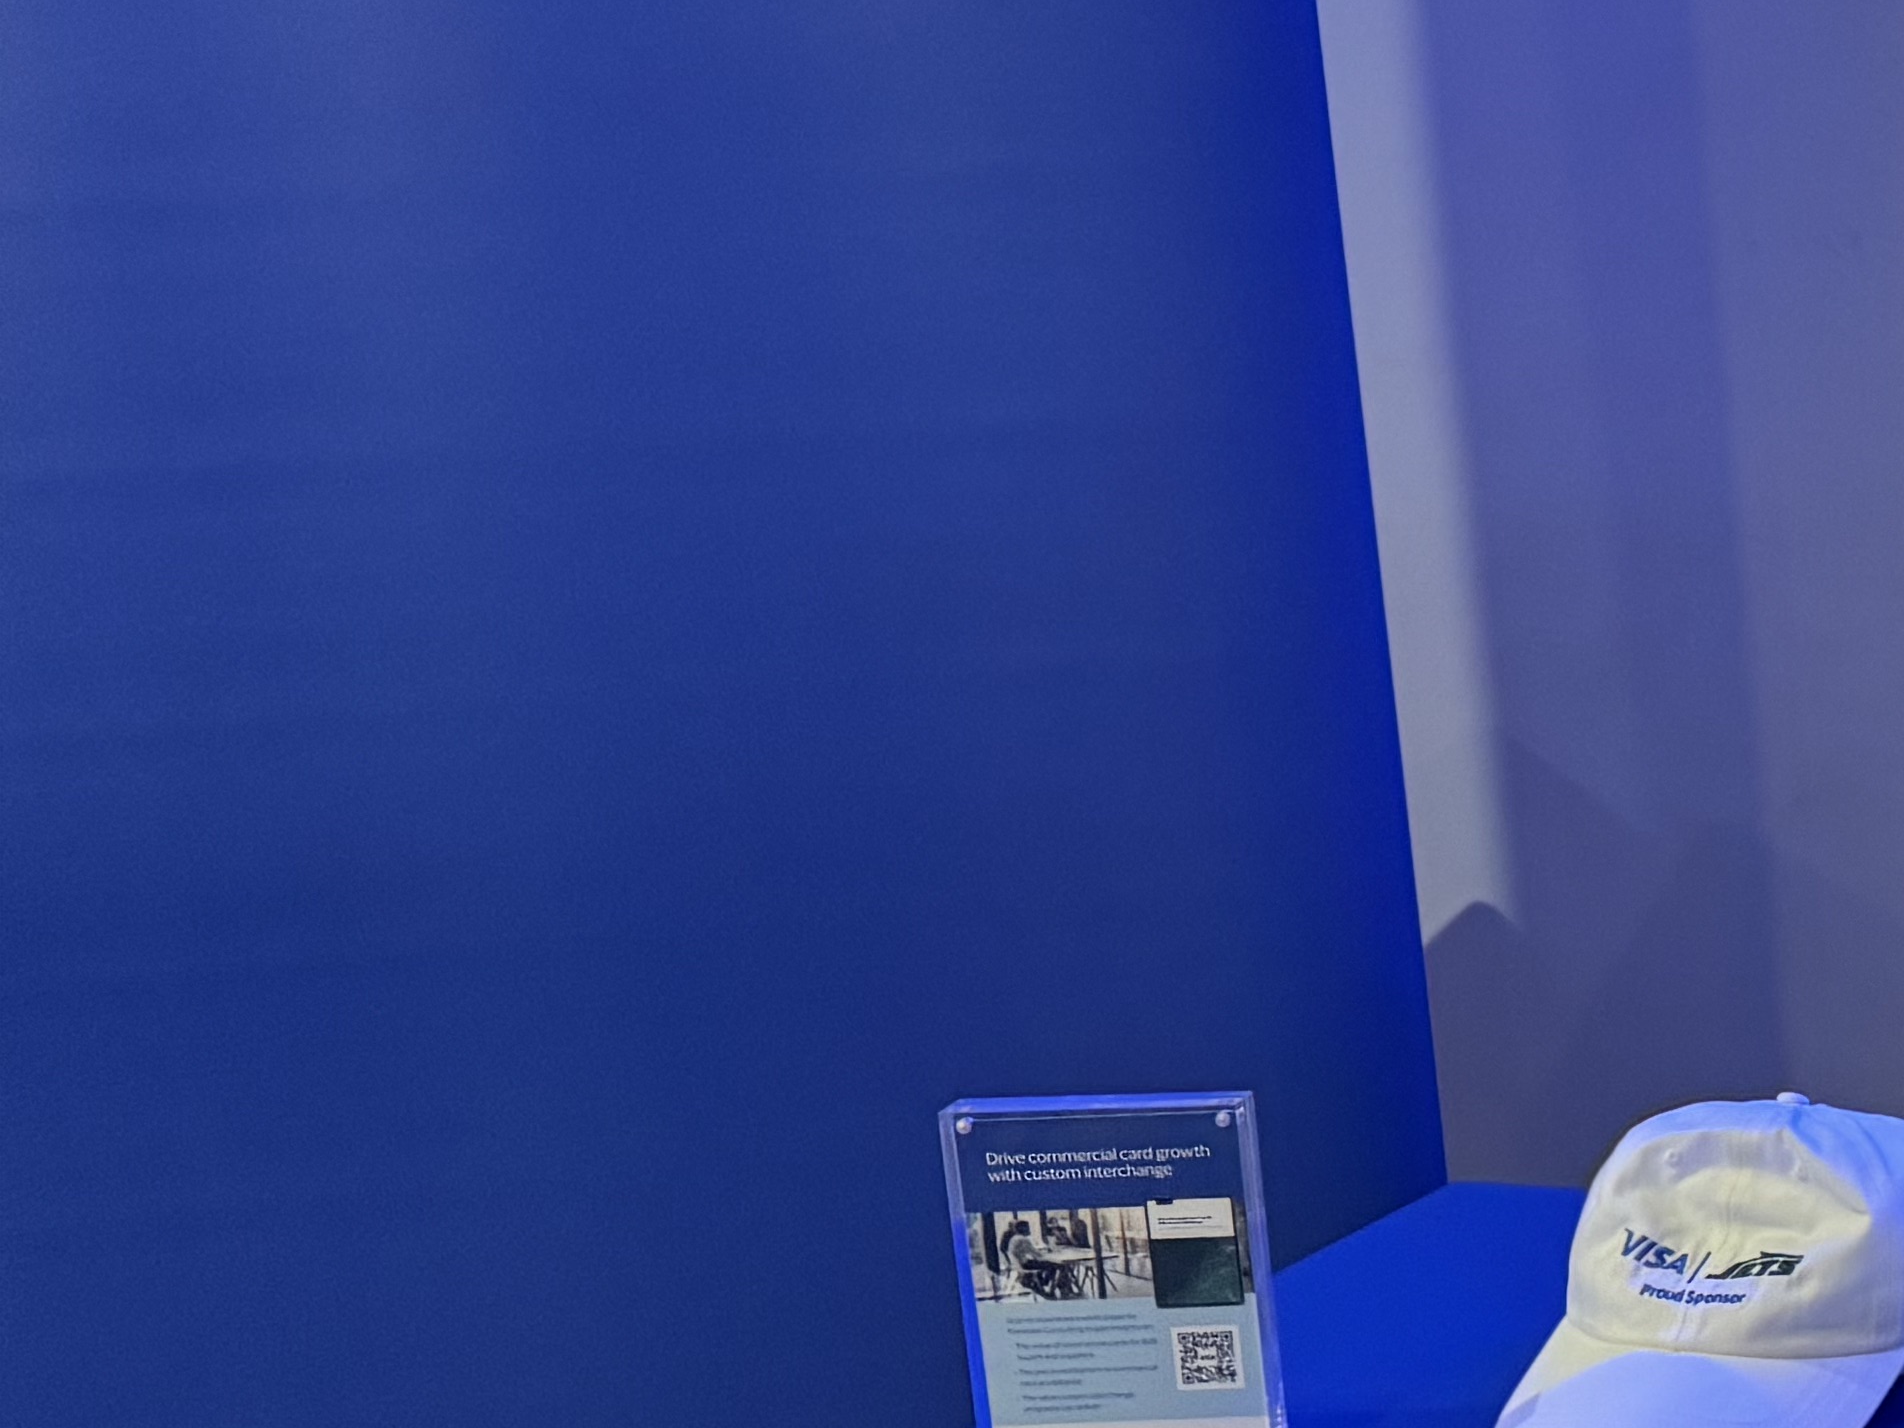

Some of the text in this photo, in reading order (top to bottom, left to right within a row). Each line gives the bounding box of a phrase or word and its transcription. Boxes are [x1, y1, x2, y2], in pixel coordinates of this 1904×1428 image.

[985, 1144, 1211, 1166] Drive commercial card growth
[987, 1163, 1174, 1183] with custom interchange
[1620, 1228, 1689, 1275] VISA
[1639, 1283, 1746, 1306] Proud Sponsor
